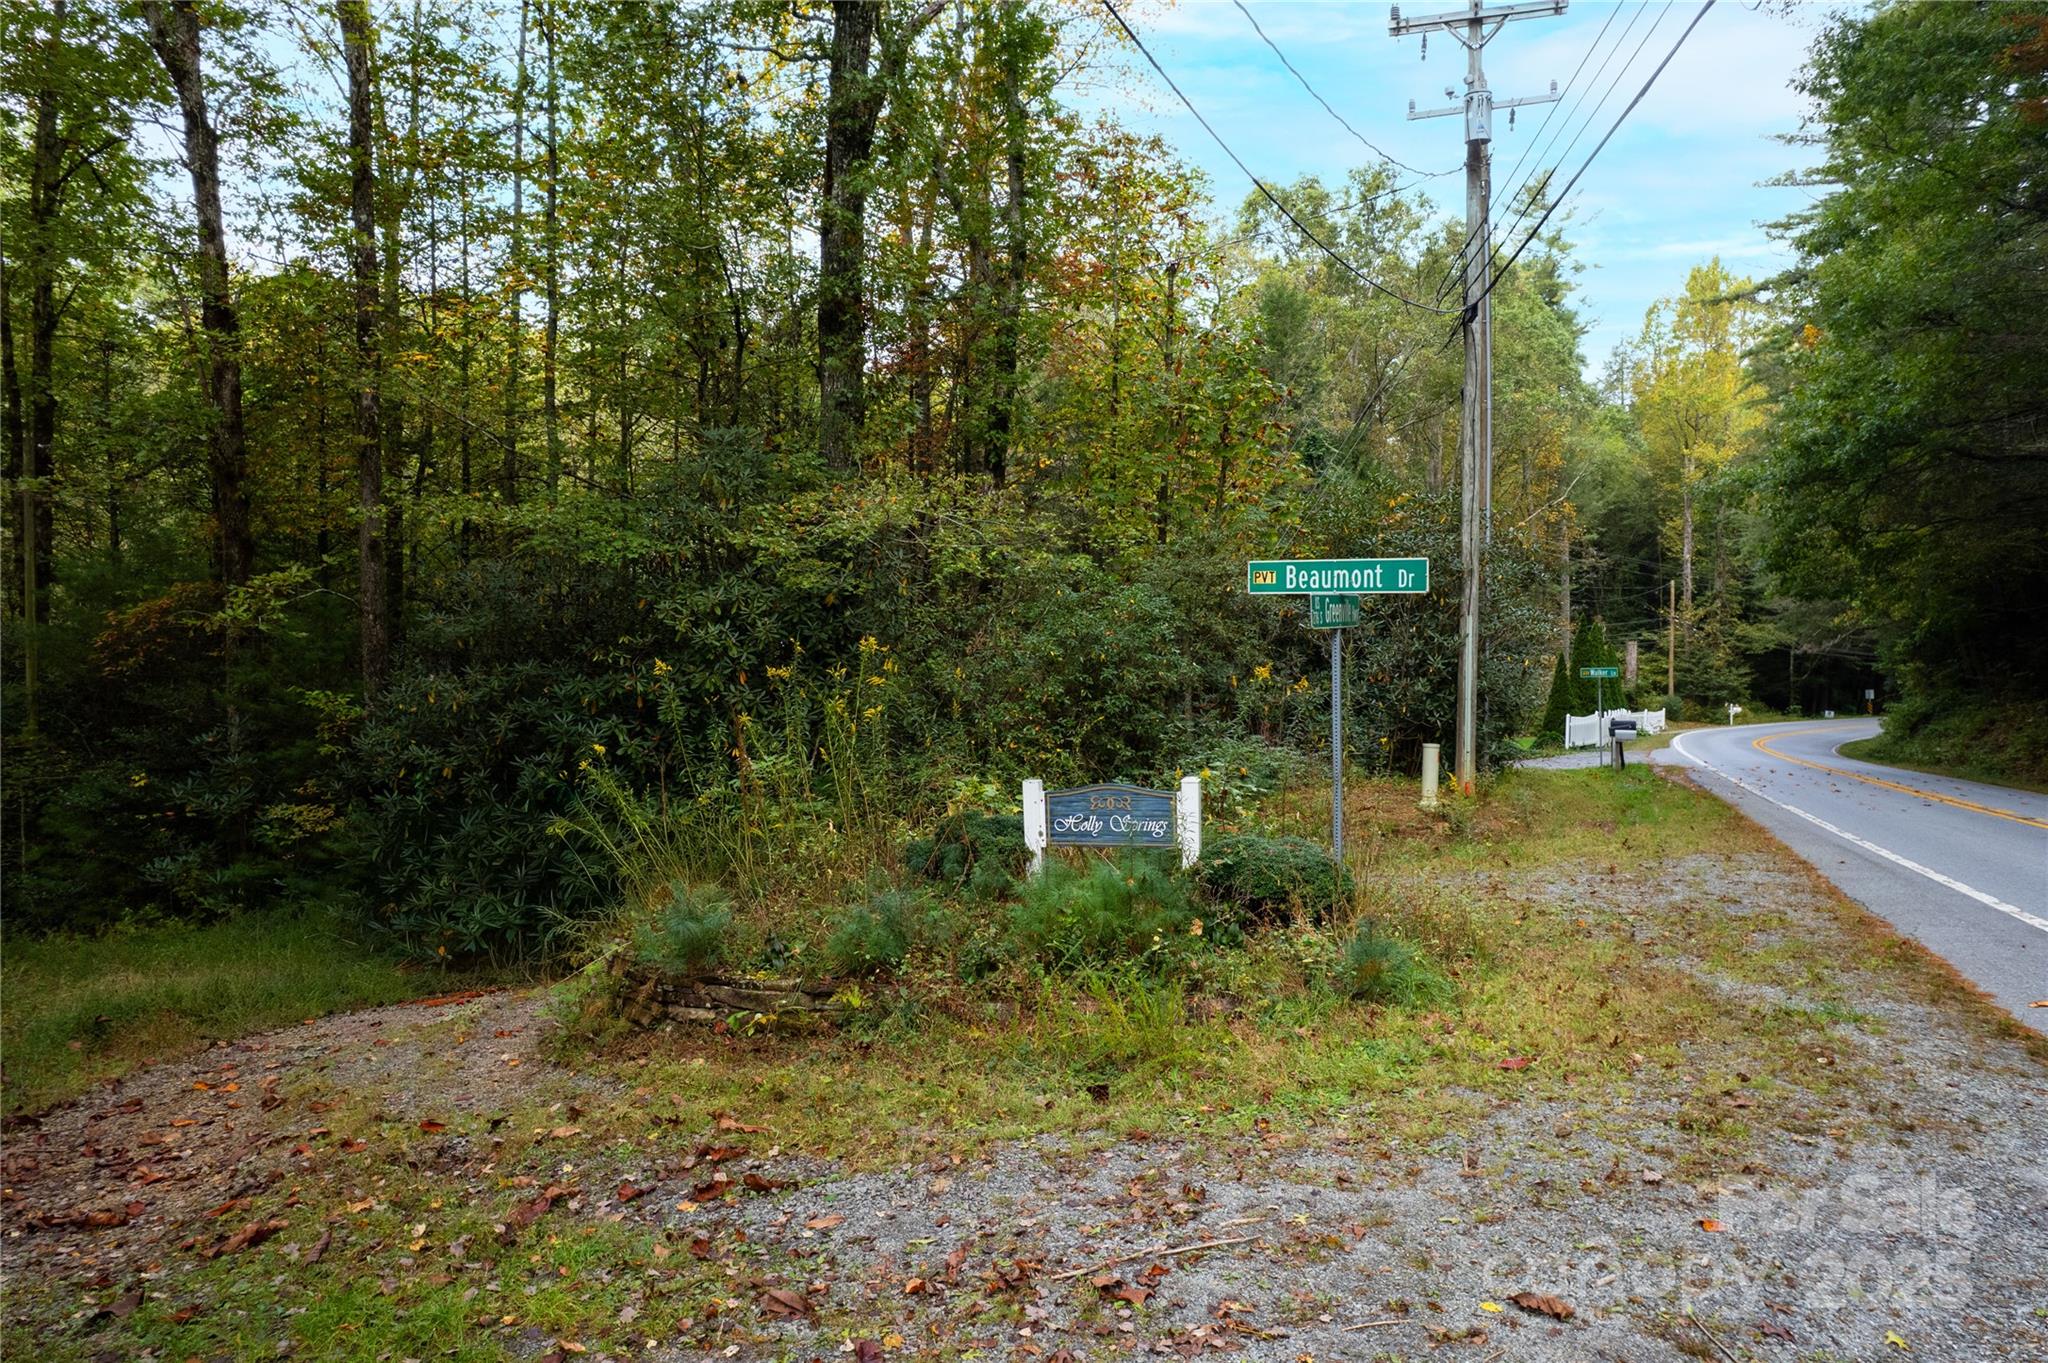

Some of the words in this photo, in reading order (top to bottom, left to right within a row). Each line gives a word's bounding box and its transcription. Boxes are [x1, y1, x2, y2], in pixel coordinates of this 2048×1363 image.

[1254, 571, 1276, 583] PVT
[1286, 564, 1383, 589] Beaumont
[1398, 569, 1415, 588] Dr
[1054, 813, 1103, 837] Holly
[1109, 814, 1169, 838] Springs
